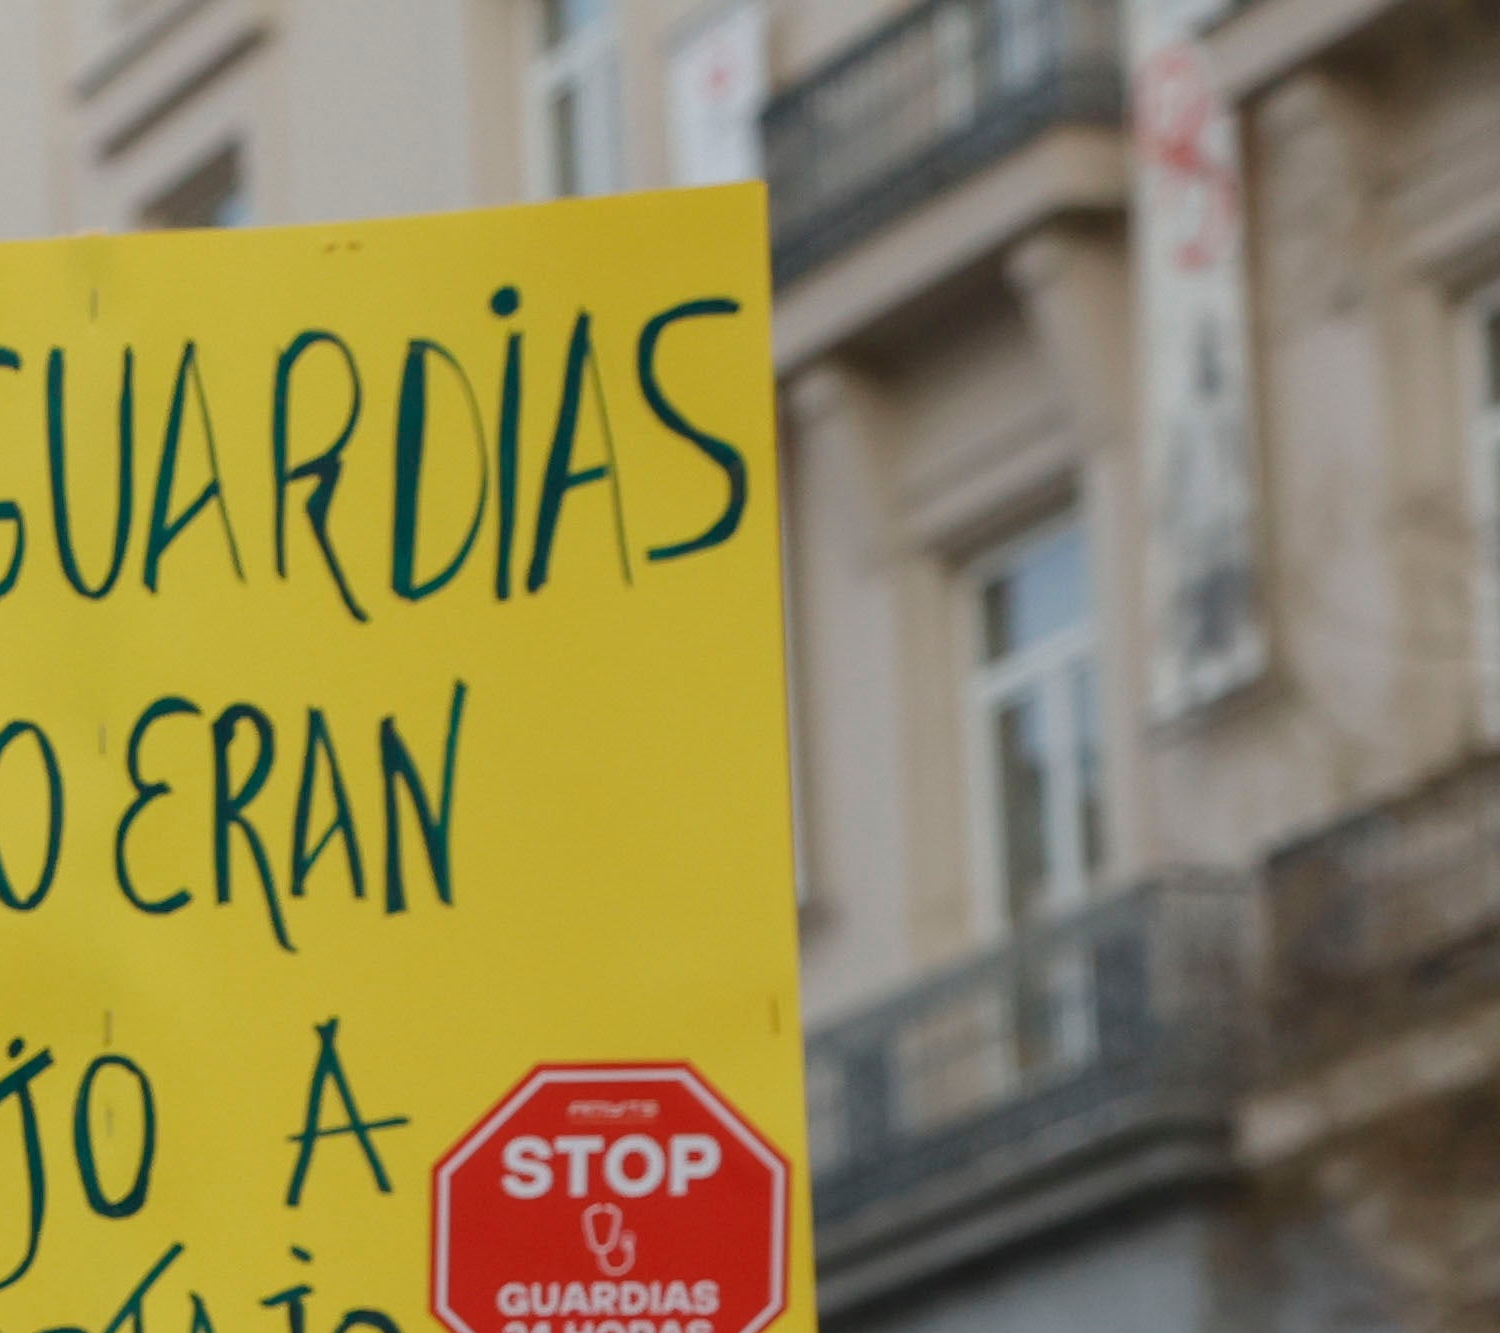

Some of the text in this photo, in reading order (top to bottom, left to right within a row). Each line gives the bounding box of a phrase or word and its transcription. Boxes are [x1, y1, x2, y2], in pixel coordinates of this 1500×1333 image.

[113, 680, 468, 953] ERAN
[286, 1018, 409, 1208] A
[500, 1133, 722, 1200] STOP
[496, 1279, 720, 1318] GUARDIAS
